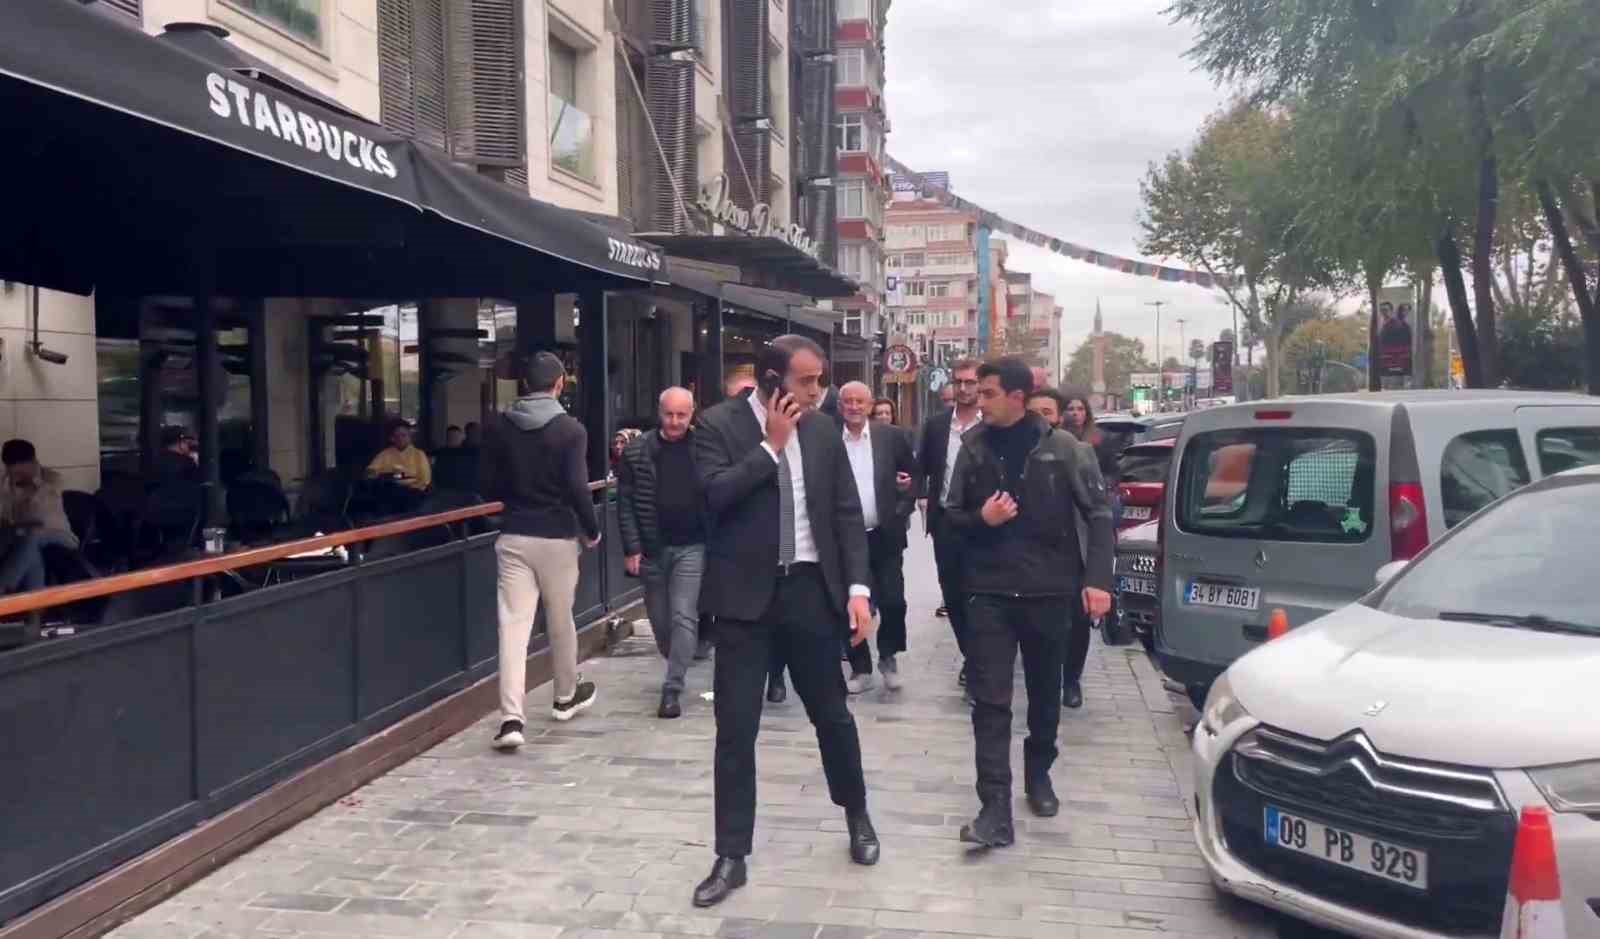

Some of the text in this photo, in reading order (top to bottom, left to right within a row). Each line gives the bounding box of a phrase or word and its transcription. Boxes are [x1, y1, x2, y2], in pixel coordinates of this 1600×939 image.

[206, 72, 397, 179] STARBUCKS
[1191, 585, 1256, 608] 34 BY 6081
[1280, 815, 1306, 849] 09
[1324, 827, 1354, 862] PB
[1371, 841, 1418, 882] 929
